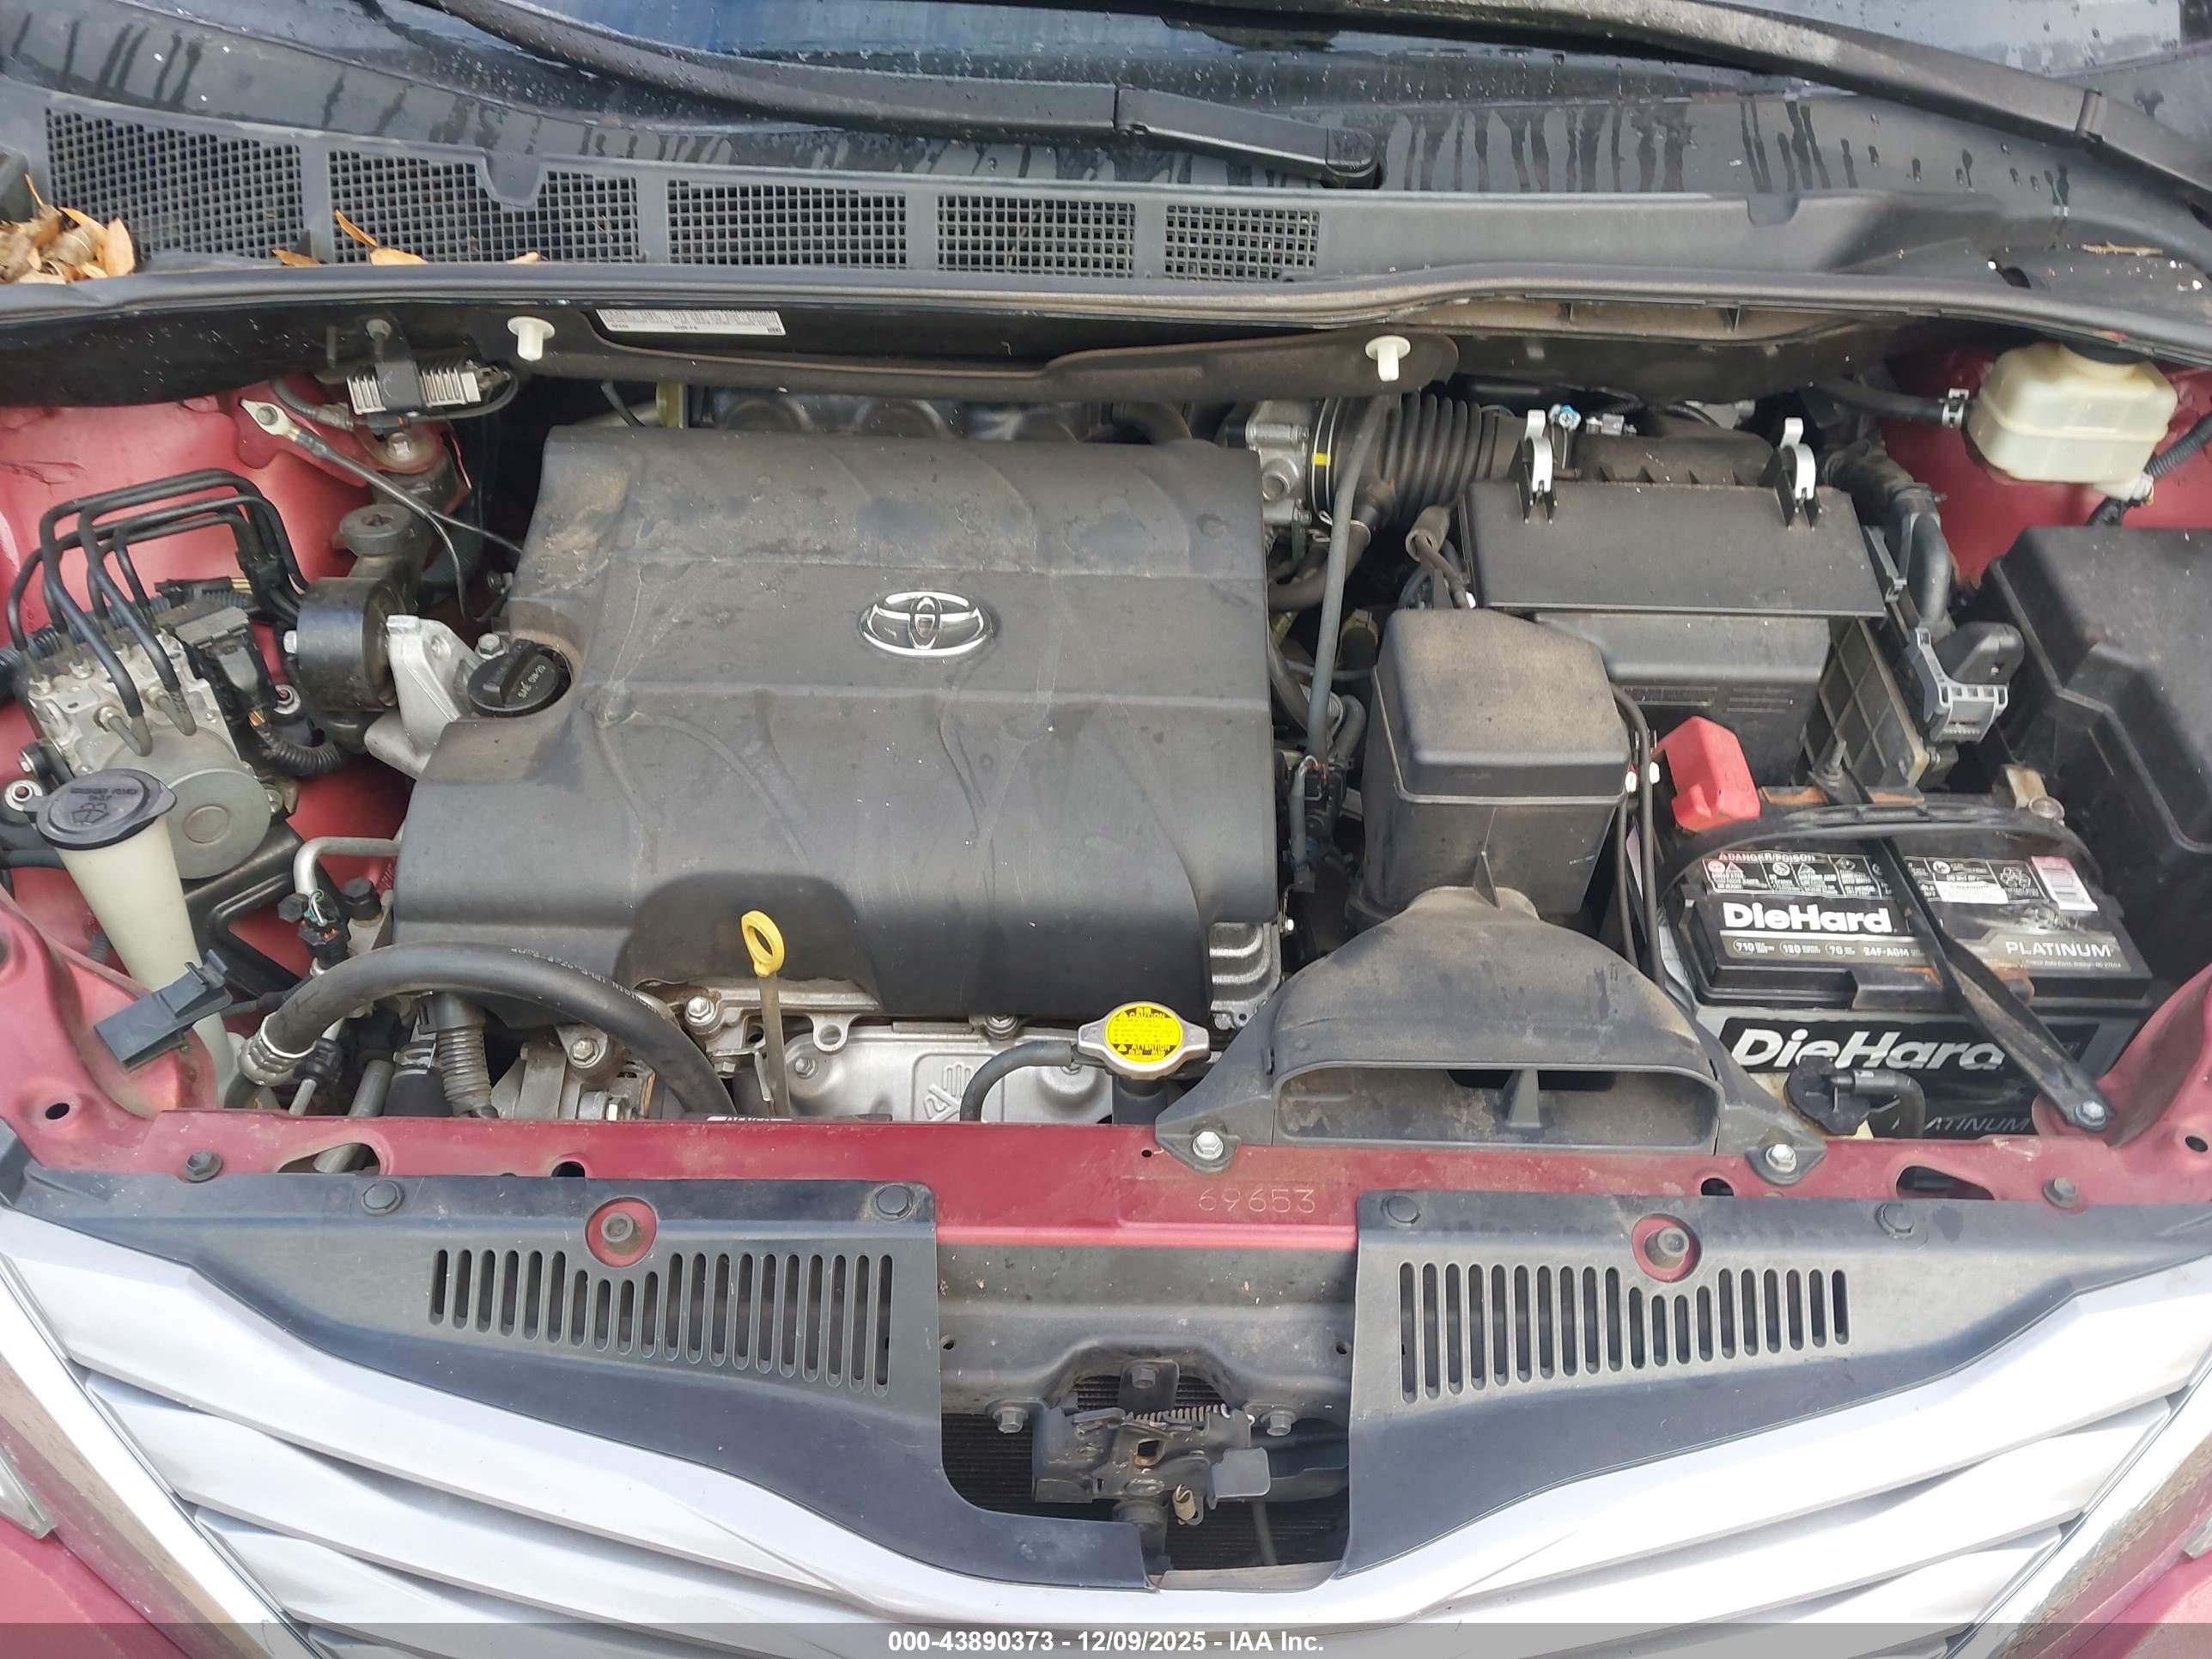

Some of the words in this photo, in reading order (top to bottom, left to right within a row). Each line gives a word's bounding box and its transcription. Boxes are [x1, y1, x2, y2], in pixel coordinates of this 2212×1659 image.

[1723, 902, 1893, 933] DieHard
[2005, 941, 2112, 957] PLATINUM
[1198, 1188, 1316, 1213] 69653
